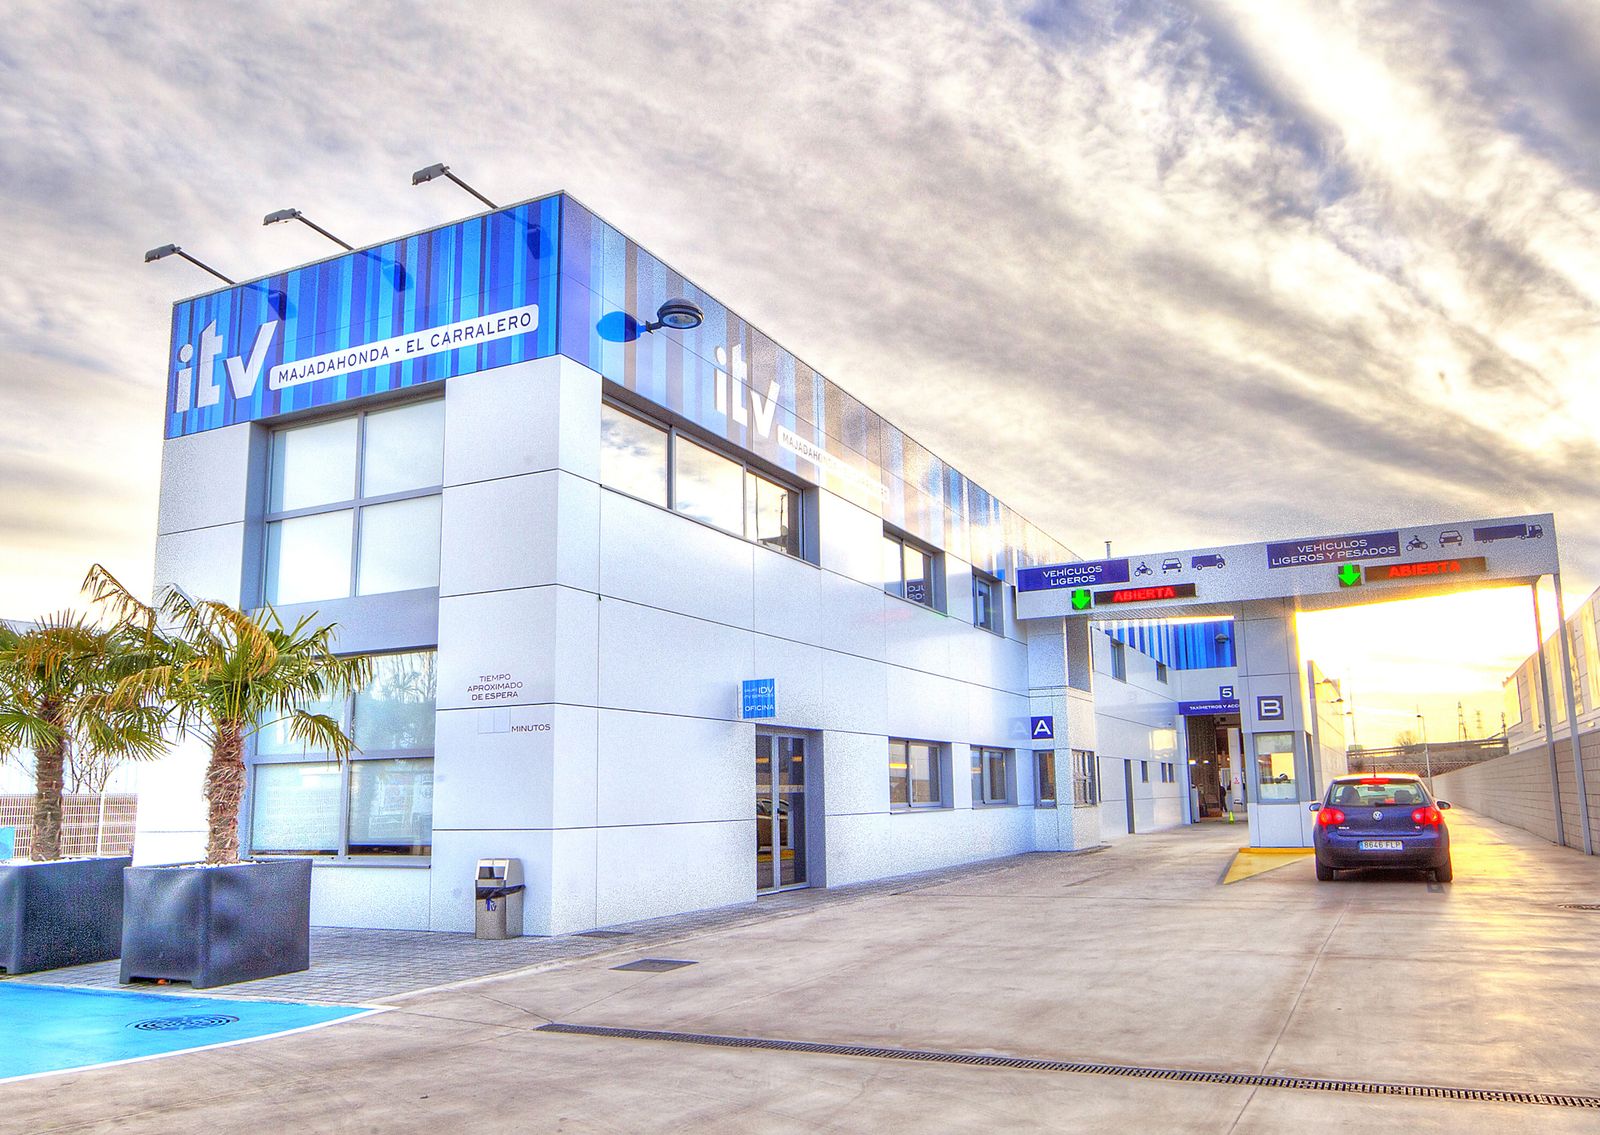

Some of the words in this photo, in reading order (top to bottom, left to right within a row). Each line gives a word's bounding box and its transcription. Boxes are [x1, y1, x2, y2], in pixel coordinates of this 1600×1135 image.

[278, 346, 390, 384] MAJADAHONDA
[406, 339, 424, 353] EL
[430, 312, 532, 348] CARRALERO
[174, 319, 278, 413] itv
[714, 343, 780, 439] itv
[1297, 539, 1368, 554] VEHÍCULOS
[1272, 553, 1325, 566] LIGEROS
[1326, 551, 1336, 560] Y
[1337, 546, 1397, 559] PESADOS
[1043, 565, 1103, 578] VEHÍCULOS
[1388, 561, 1461, 578] ABIERTA
[1050, 575, 1096, 586] LIGEROS
[1112, 586, 1176, 603] ABIERTA
[480, 673, 511, 683] TIEMPO
[467, 681, 523, 692] APROXIMADO
[1222, 687, 1233, 698] 5
[471, 693, 484, 701] DE
[485, 691, 519, 700] ESPERA
[744, 704, 774, 712] OFICINA
[1260, 699, 1281, 717] B
[511, 723, 551, 733] MINUTOS
[1033, 719, 1052, 736] A
